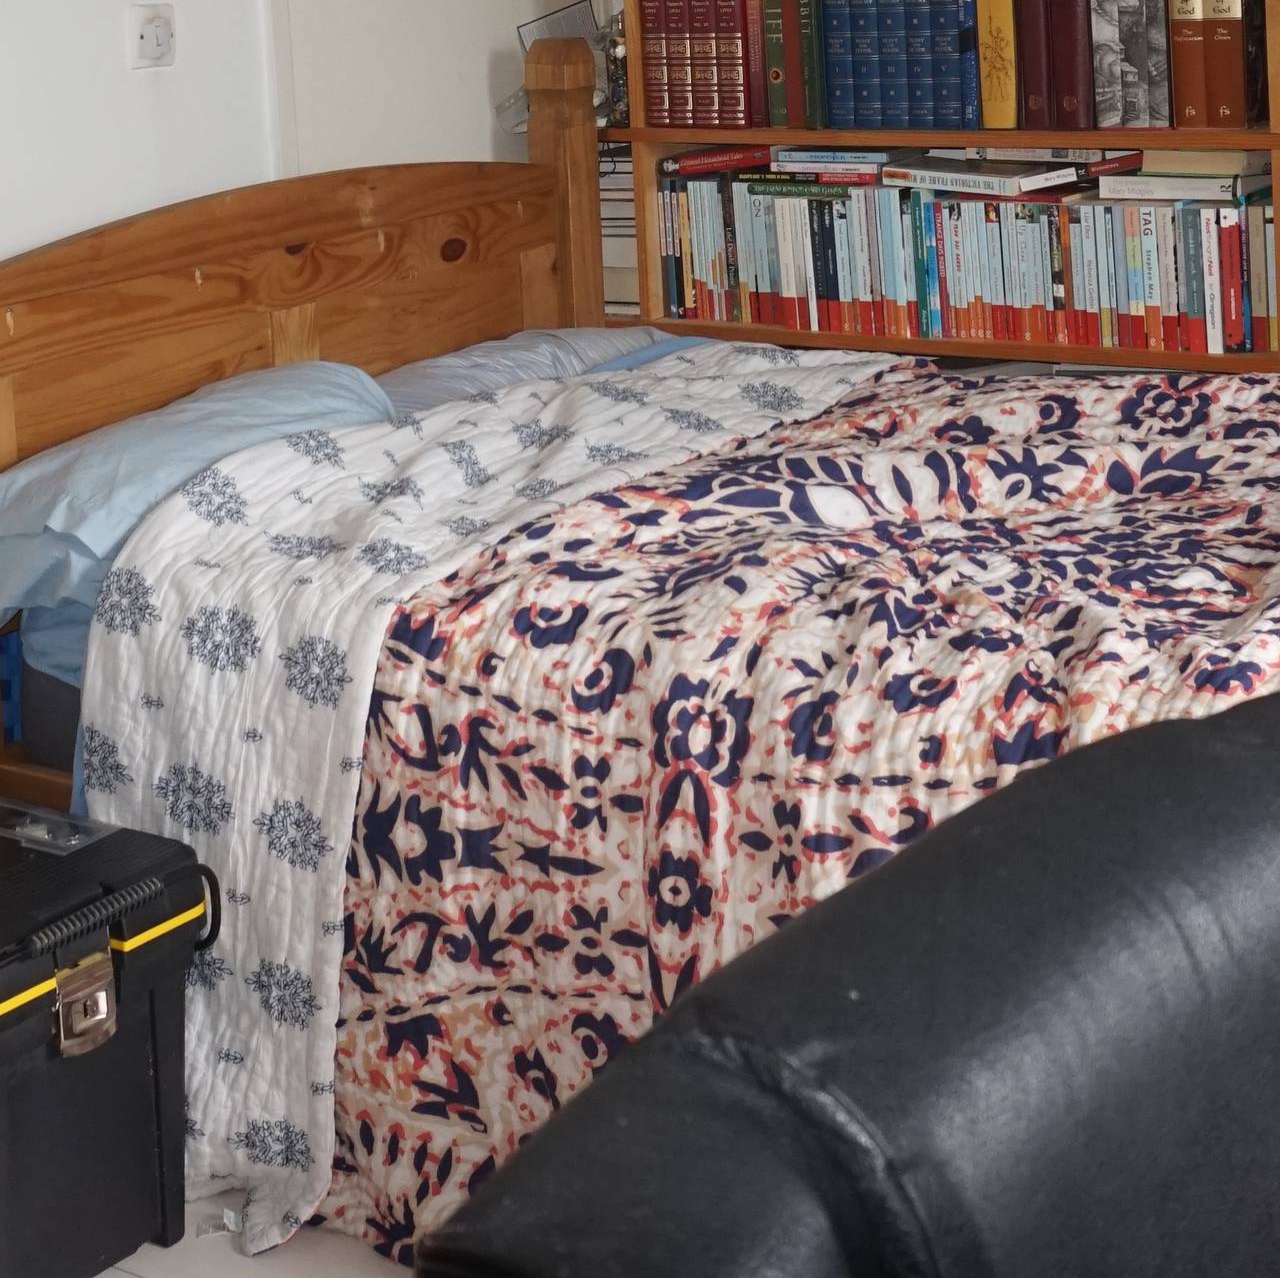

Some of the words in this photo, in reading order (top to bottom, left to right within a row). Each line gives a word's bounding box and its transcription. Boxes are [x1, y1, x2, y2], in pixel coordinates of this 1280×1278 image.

[1177, 6, 1195, 16] God
[1142, 210, 1153, 235] TAG
[1146, 283, 1154, 299] May
